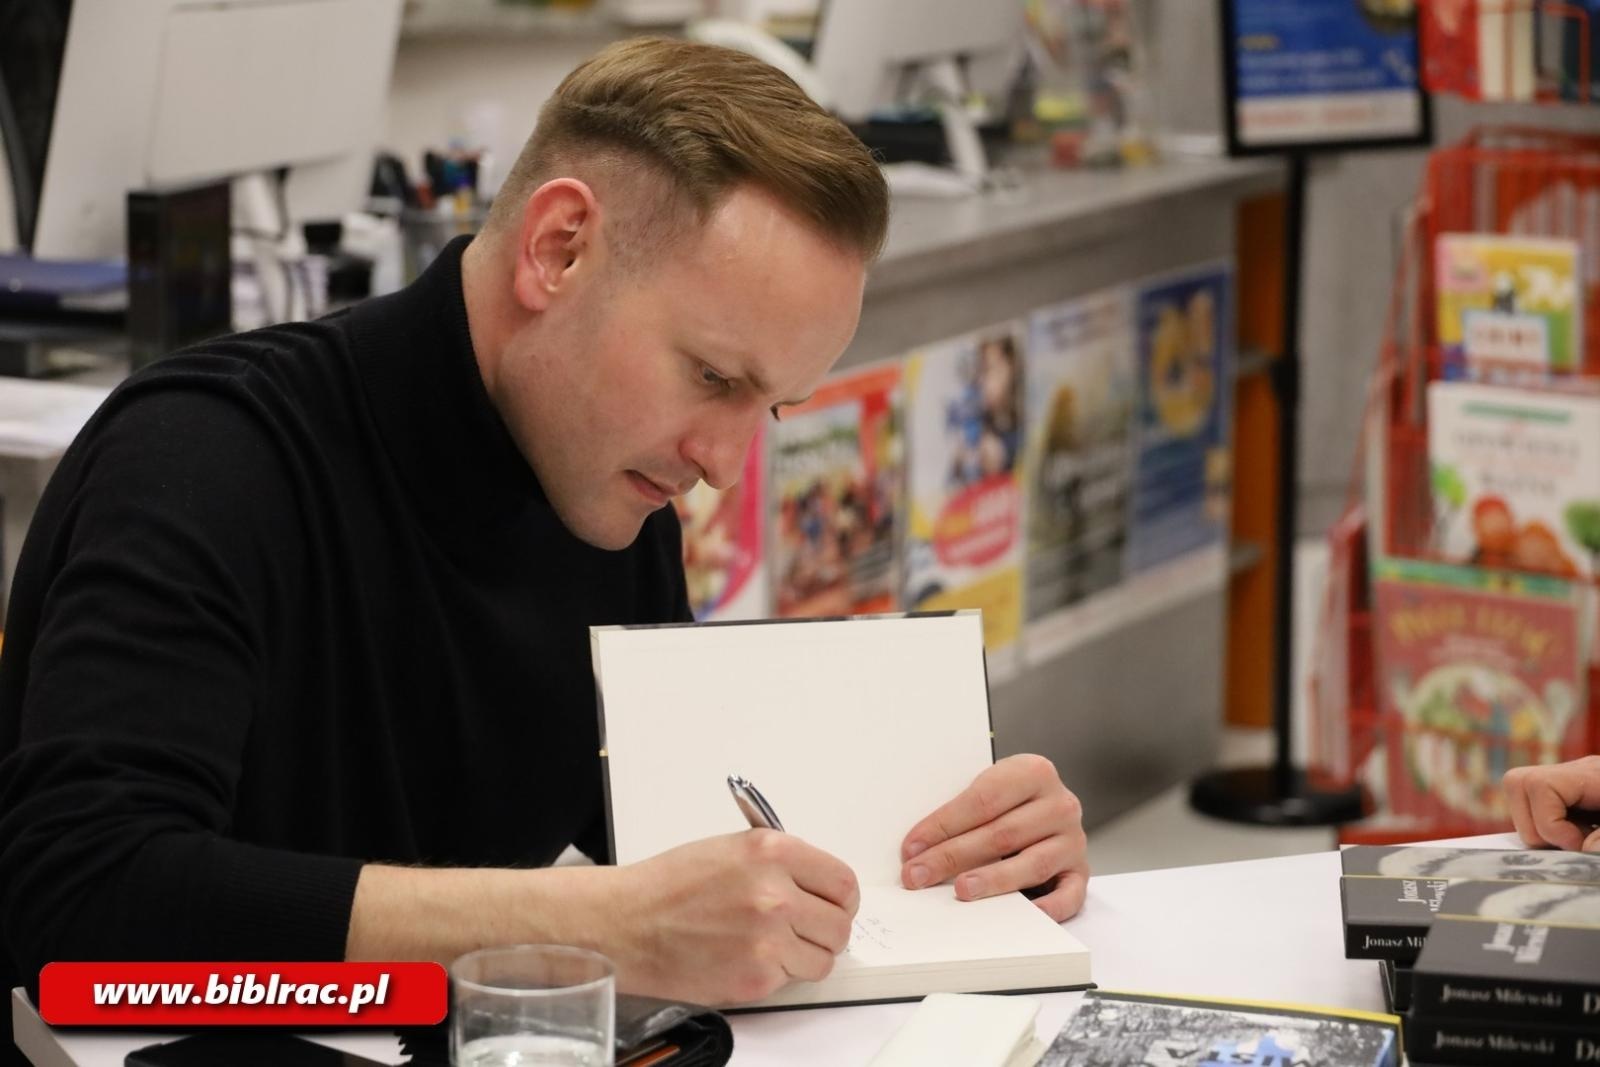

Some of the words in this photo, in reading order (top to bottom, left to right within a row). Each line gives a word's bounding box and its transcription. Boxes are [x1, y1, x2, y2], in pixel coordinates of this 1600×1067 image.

[1362, 934, 1403, 950] Jonasz
[1407, 935, 1426, 949] Mil
[1442, 984, 1491, 1003] Jonasz
[1494, 987, 1562, 1007] Milewski
